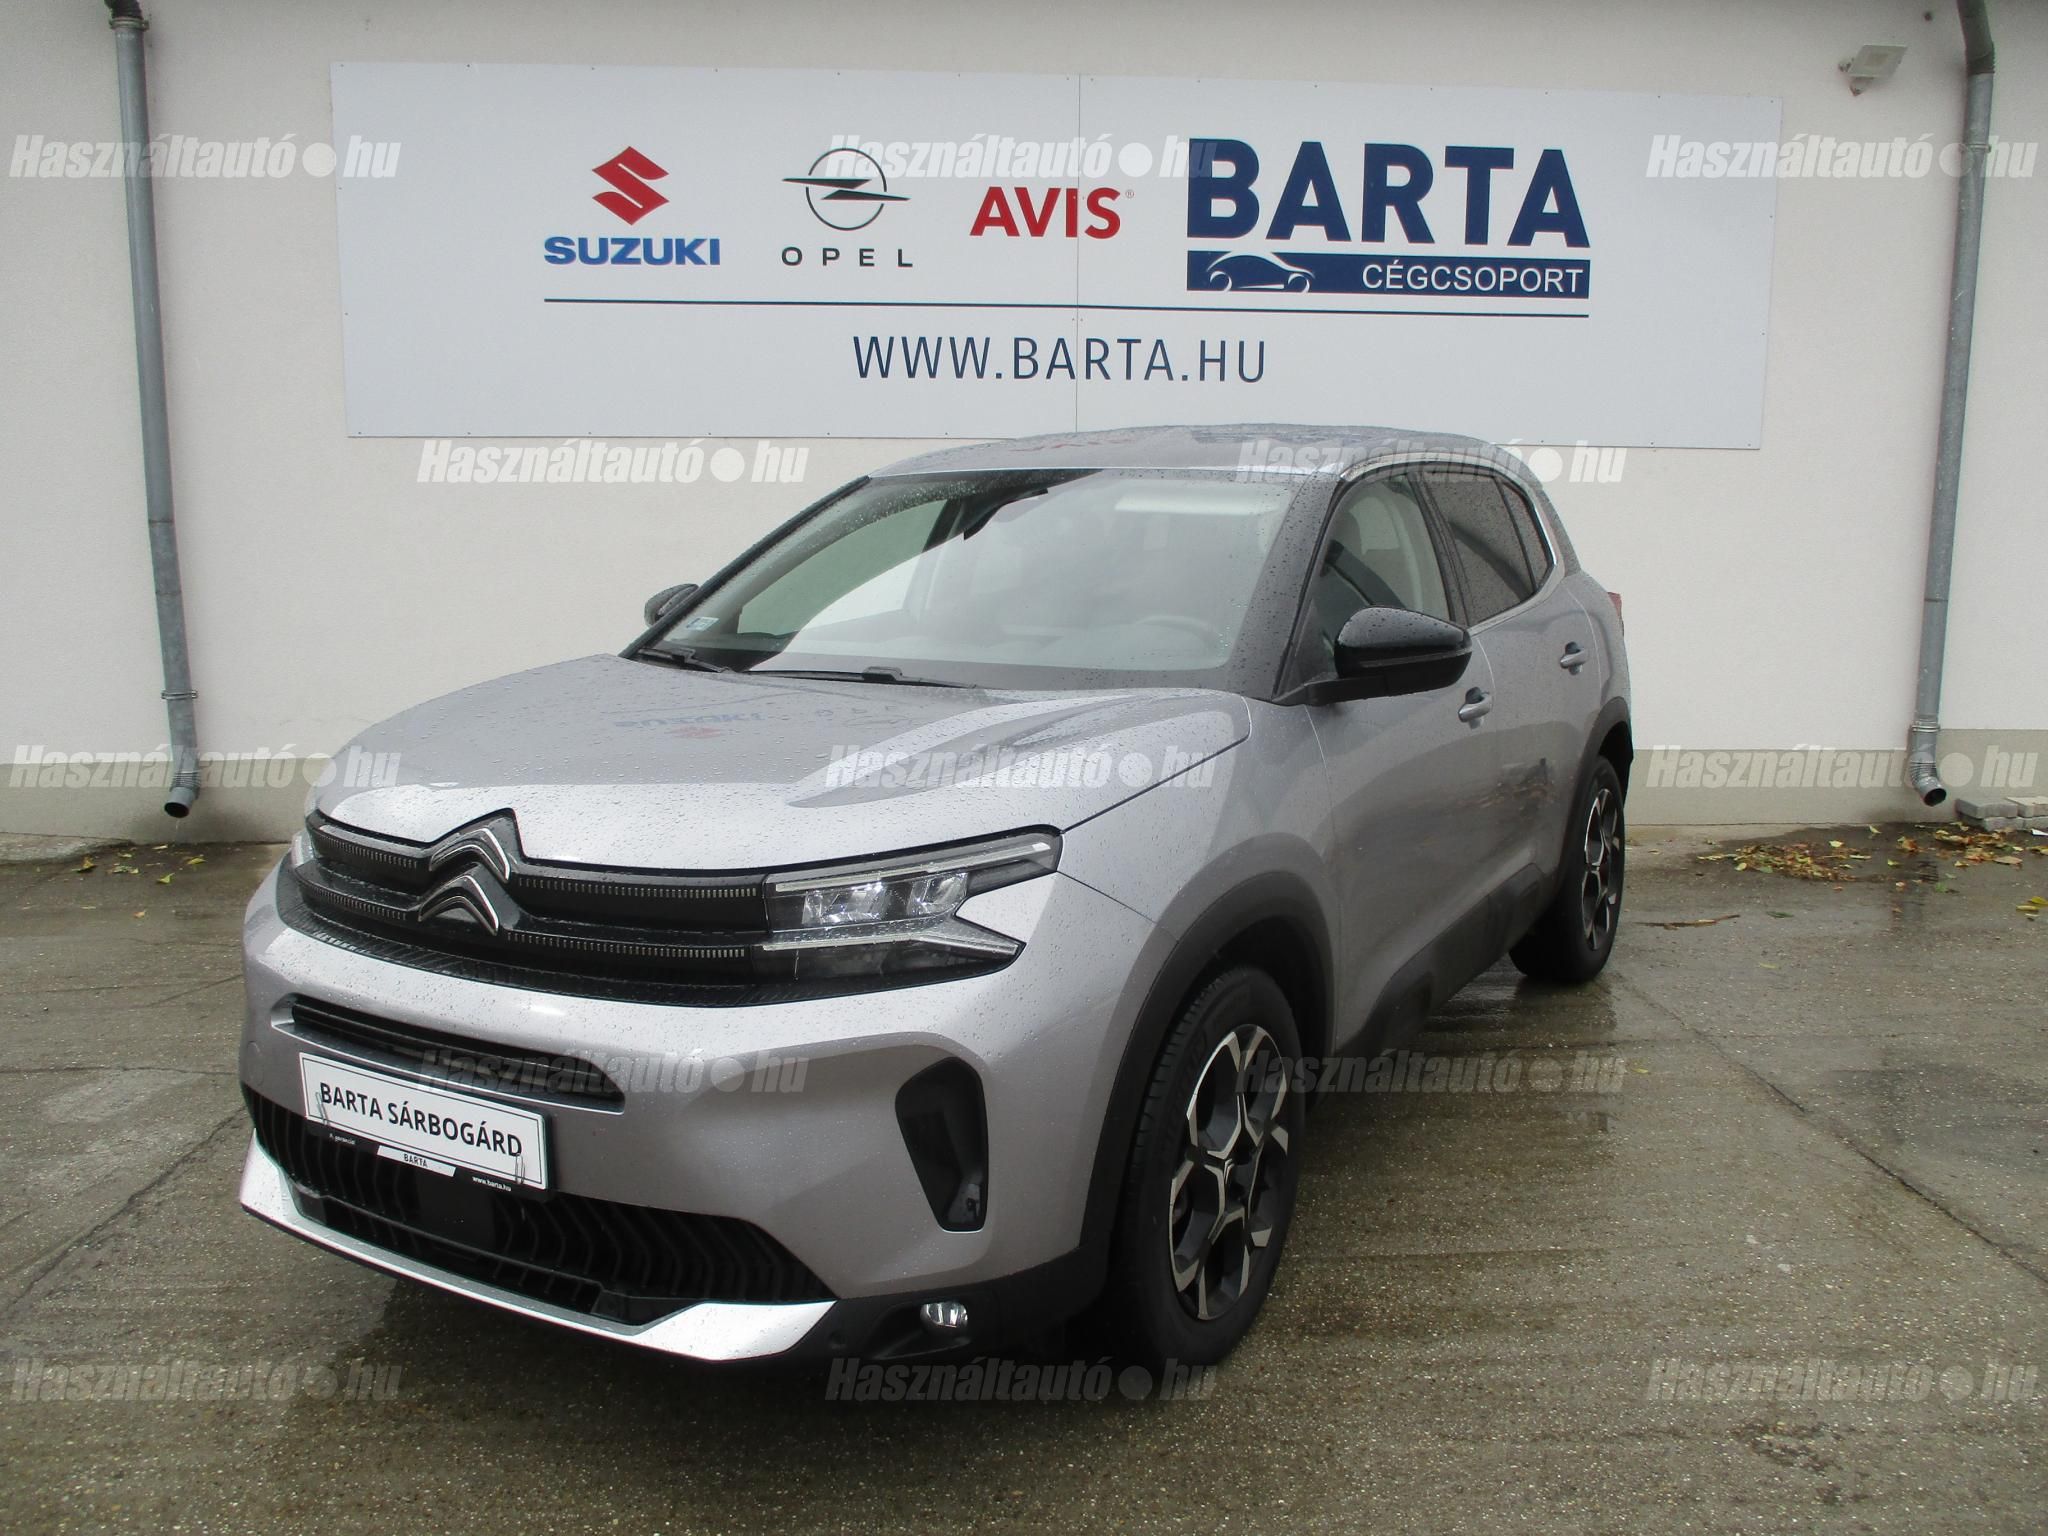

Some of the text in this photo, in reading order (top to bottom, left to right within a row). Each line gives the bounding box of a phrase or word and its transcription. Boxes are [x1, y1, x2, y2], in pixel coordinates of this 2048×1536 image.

[1187, 138, 1591, 248] BARTA
[544, 235, 721, 267] SUZUKI
[781, 245, 914, 268] OPEL
[1361, 259, 1584, 294] CÉGCSOPORT
[852, 336, 1266, 384] WWW.BARTA.HU
[319, 1082, 523, 1157] BARTA SÁRBOGÁRD
[402, 1153, 429, 1168] BARTA
